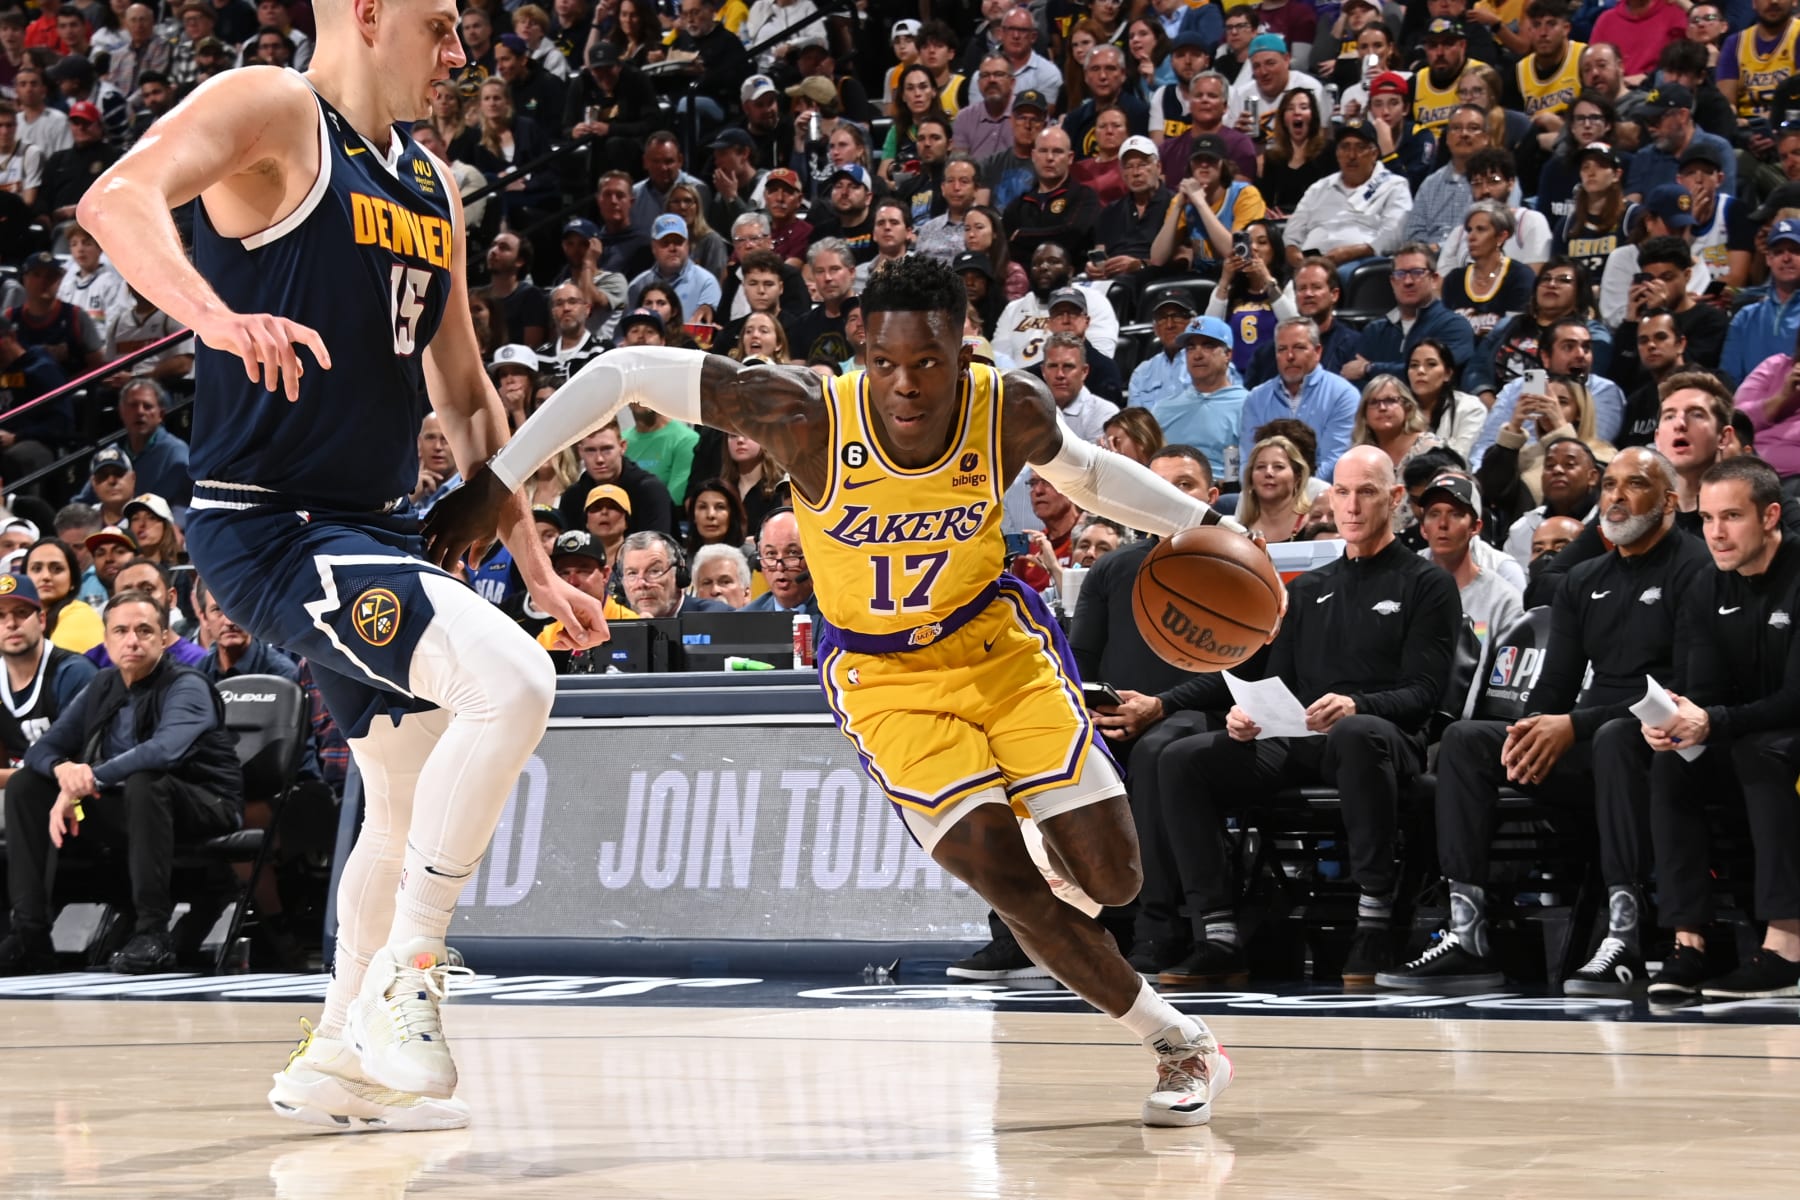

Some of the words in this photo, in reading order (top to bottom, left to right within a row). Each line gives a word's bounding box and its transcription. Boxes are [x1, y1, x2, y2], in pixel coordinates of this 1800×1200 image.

[412, 158, 432, 178] WU
[350, 191, 452, 272] DENVER
[390, 263, 433, 356] 15
[1240, 315, 1258, 345] 6
[847, 445, 863, 466] 6
[952, 473, 987, 487] bibigo
[823, 500, 989, 548] LAKERS
[869, 549, 951, 615] 17
[1161, 601, 1248, 657] Wilson
[233, 693, 277, 702] LEXUS
[598, 770, 762, 890] JOIN
